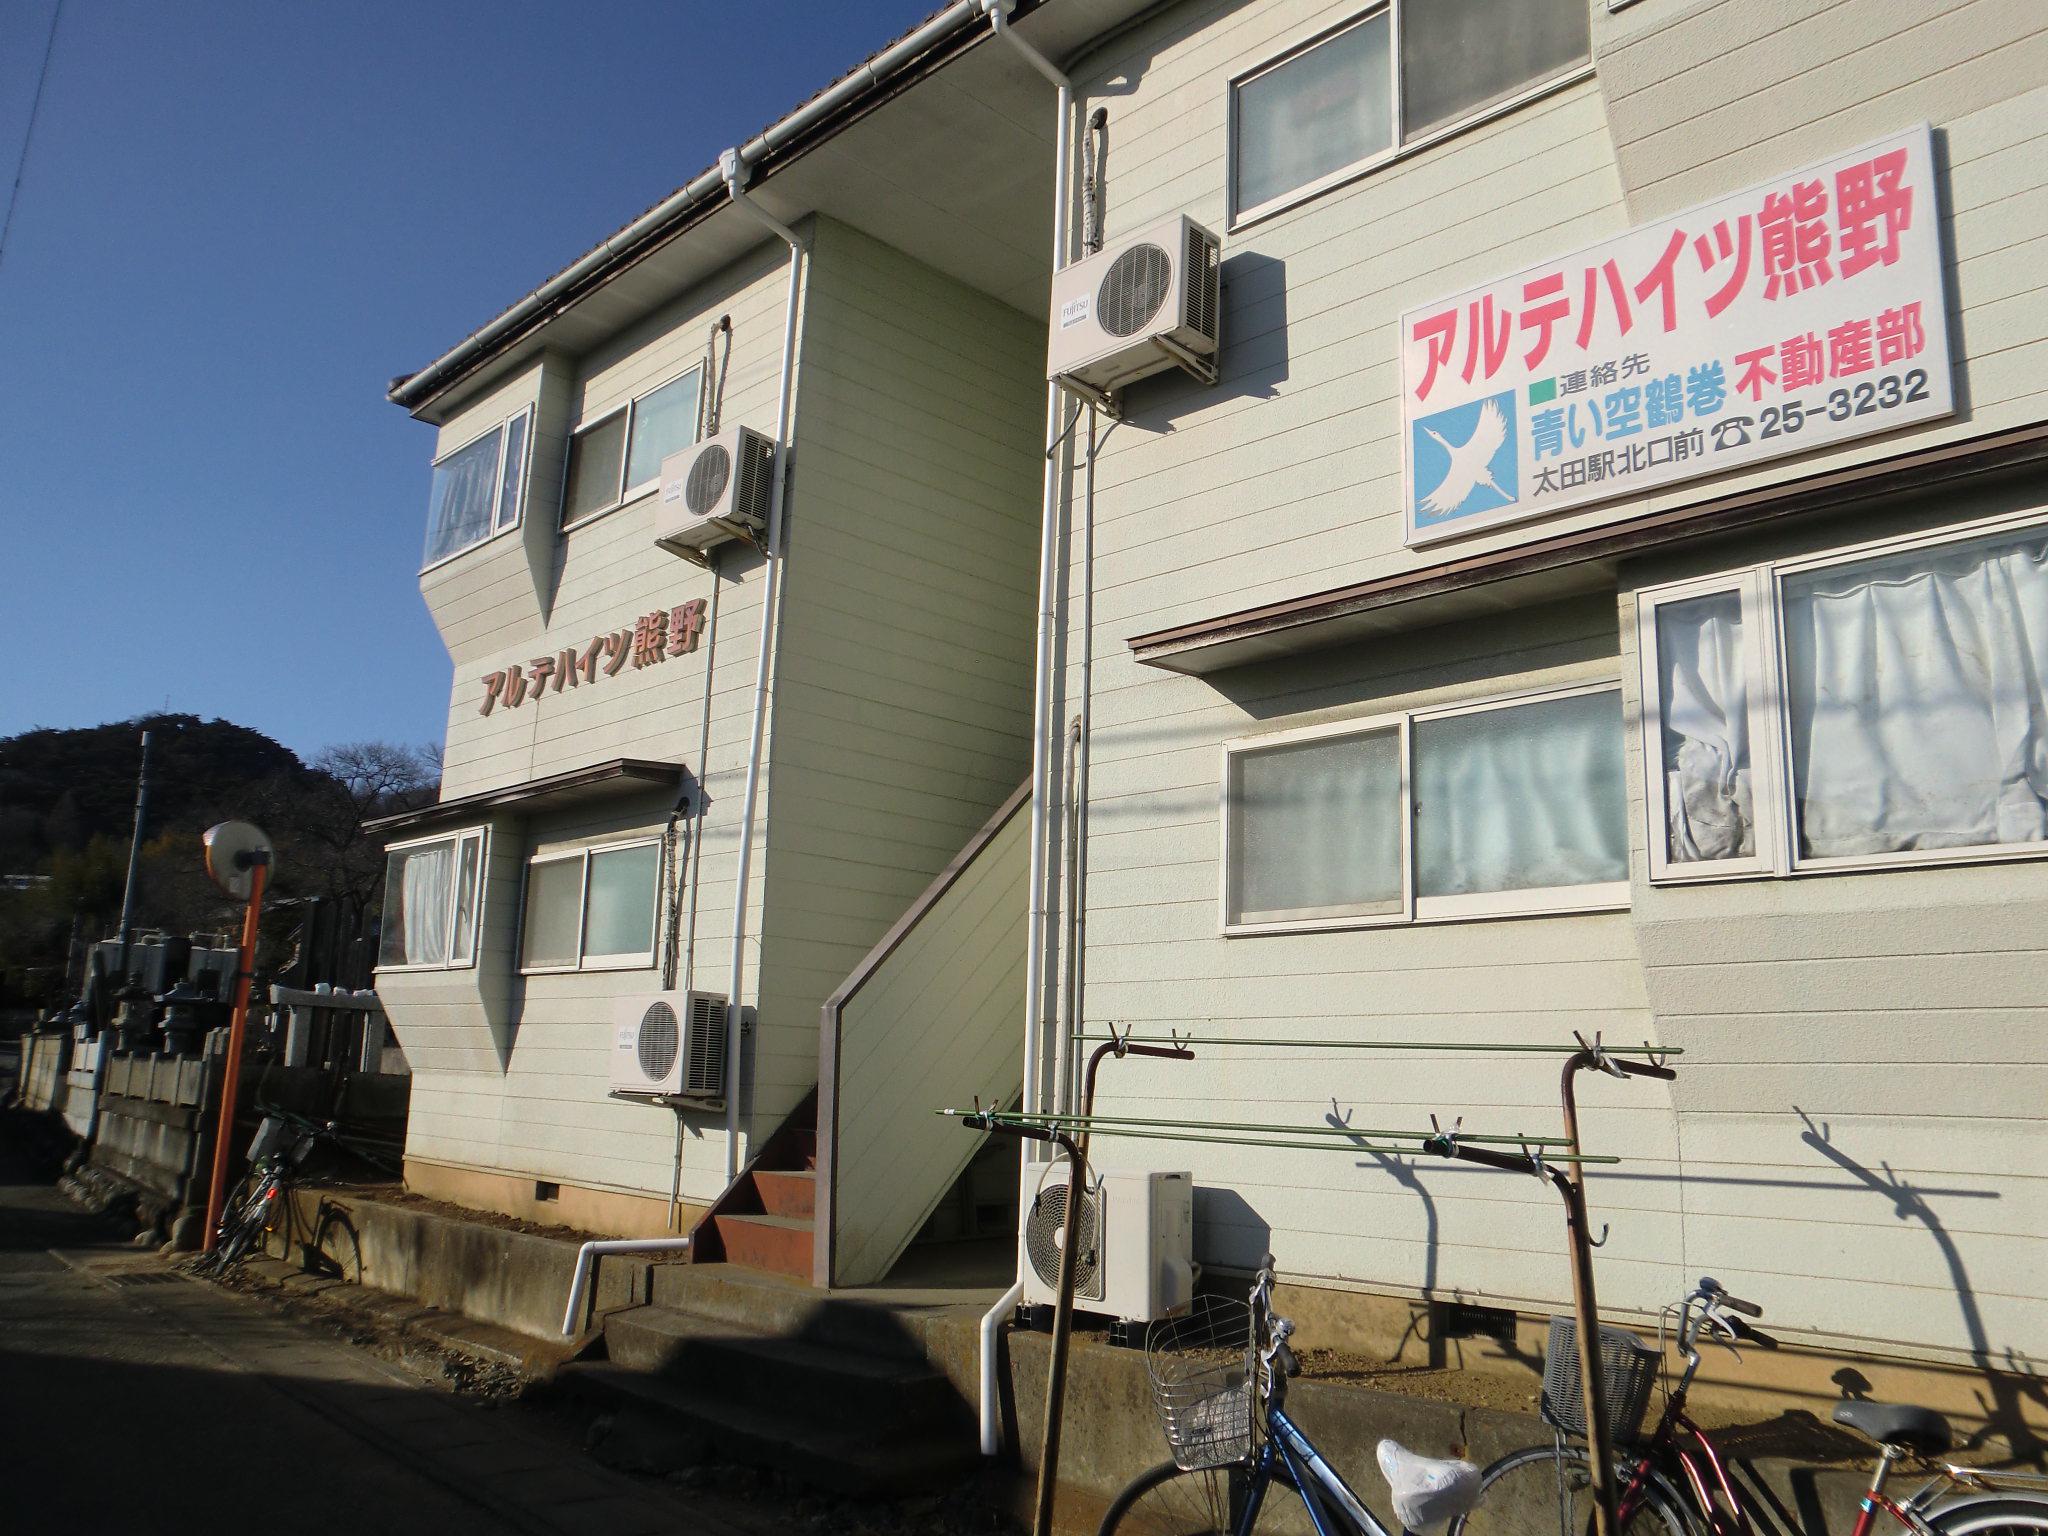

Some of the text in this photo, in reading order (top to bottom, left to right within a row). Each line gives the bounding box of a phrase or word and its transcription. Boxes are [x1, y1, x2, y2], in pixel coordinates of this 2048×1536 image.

[1413, 147, 1914, 401] アルテハイツ熊野
[1531, 301, 1925, 462] 青い空鶴巻 不動産部
[1533, 368, 1930, 497] 太田駅北口前 25-3232
[1560, 353, 1650, 397] 連絡先
[479, 598, 708, 717] アルテハイツ熊野
